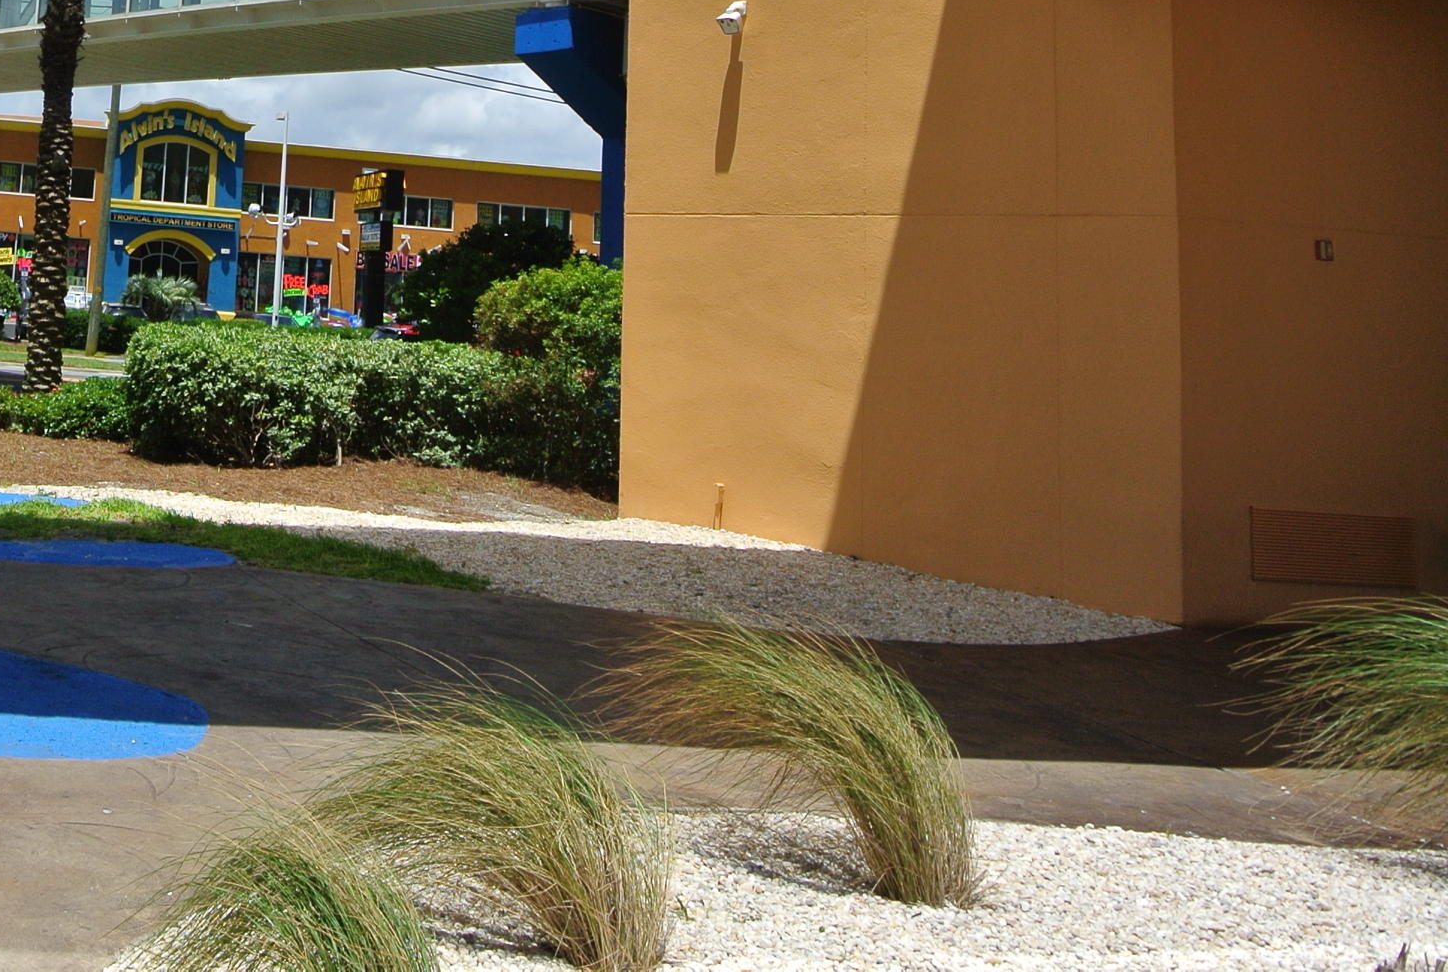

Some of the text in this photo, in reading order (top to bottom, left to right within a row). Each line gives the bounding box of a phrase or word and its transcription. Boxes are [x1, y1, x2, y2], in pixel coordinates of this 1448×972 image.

[119, 110, 237, 163] Alvin's Island
[113, 213, 234, 230] TROPICAL DEPARTMENT STORE
[284, 274, 306, 289] FREE
